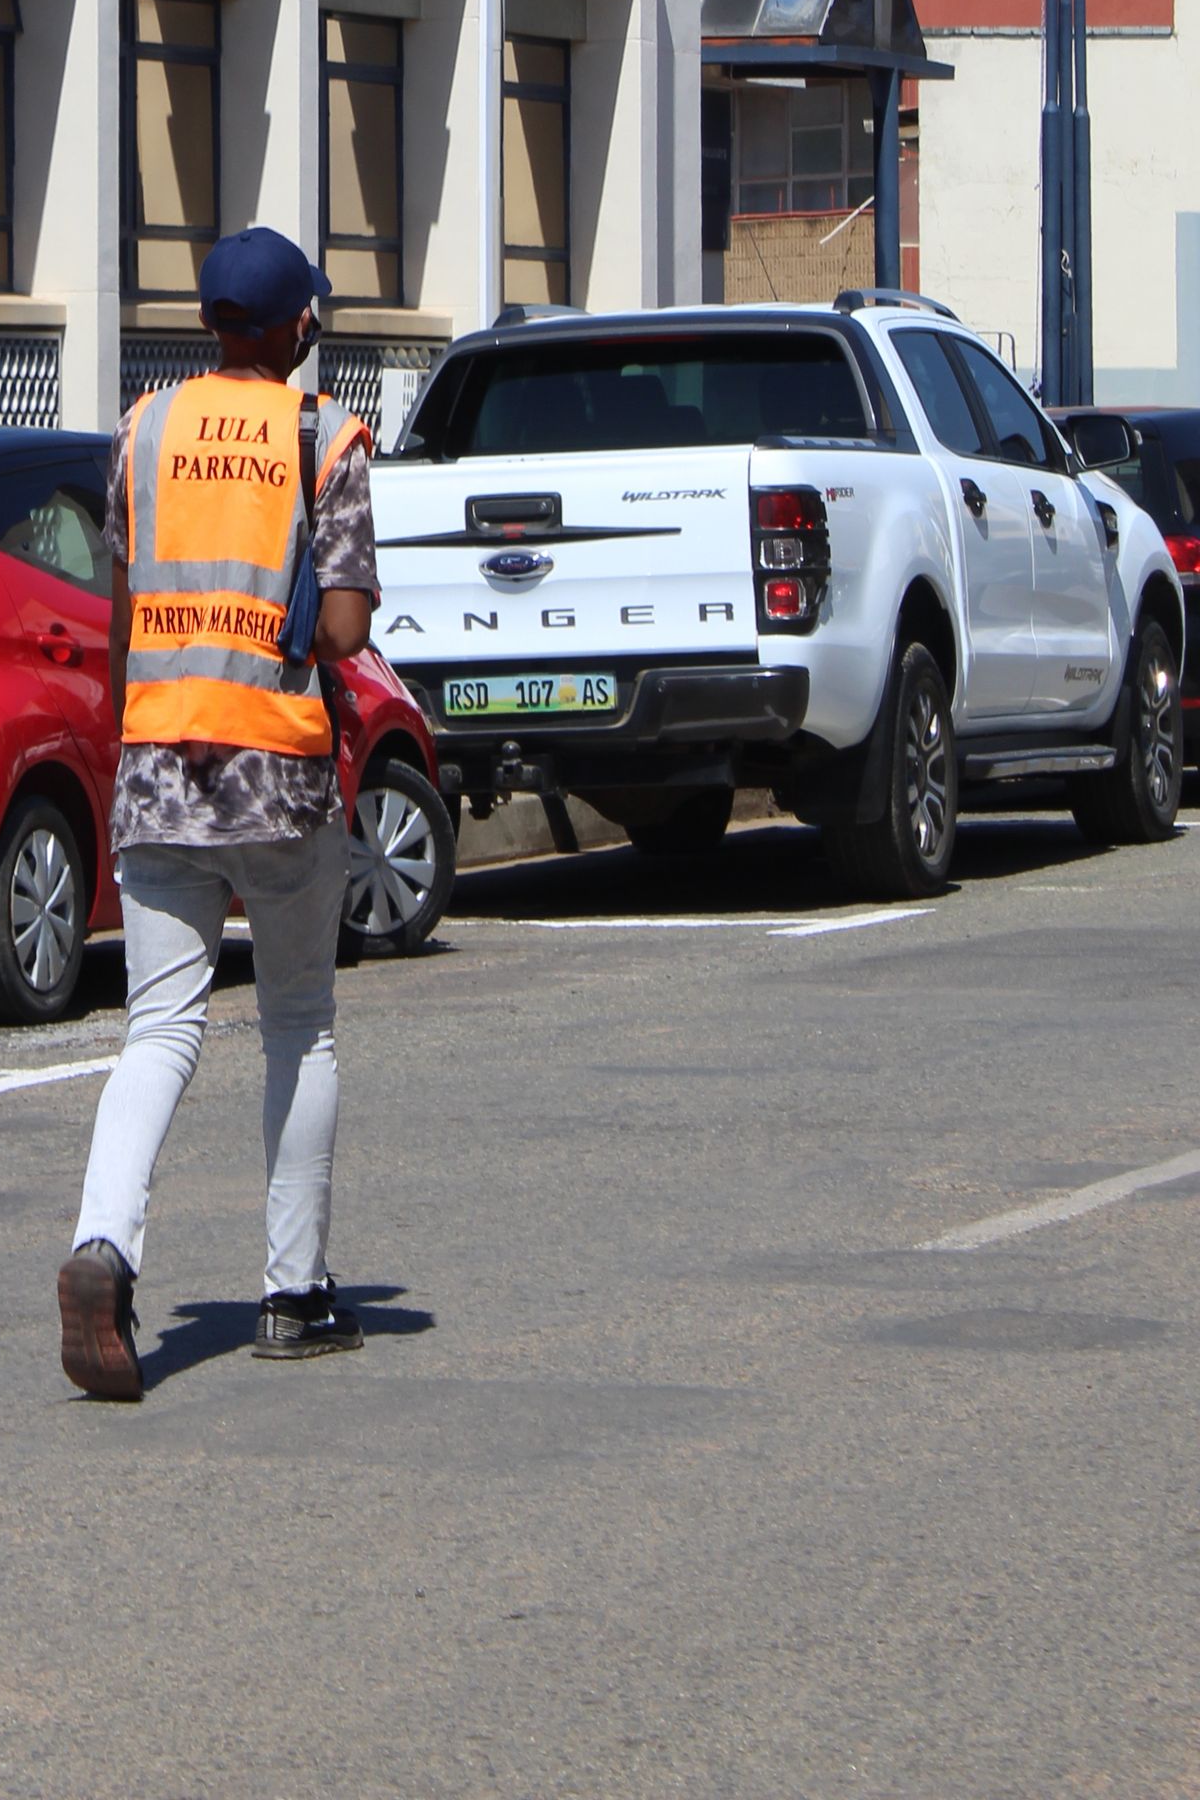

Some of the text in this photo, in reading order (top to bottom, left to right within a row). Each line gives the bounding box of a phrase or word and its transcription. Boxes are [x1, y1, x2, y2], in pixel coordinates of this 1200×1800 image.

[196, 415, 269, 444] LULA
[171, 454, 287, 488] PARKING
[621, 487, 728, 503] WILDTRAK
[142, 606, 206, 634] PARKIN
[385, 601, 735, 635] ANGER
[449, 677, 609, 712] RSD 107 AS
